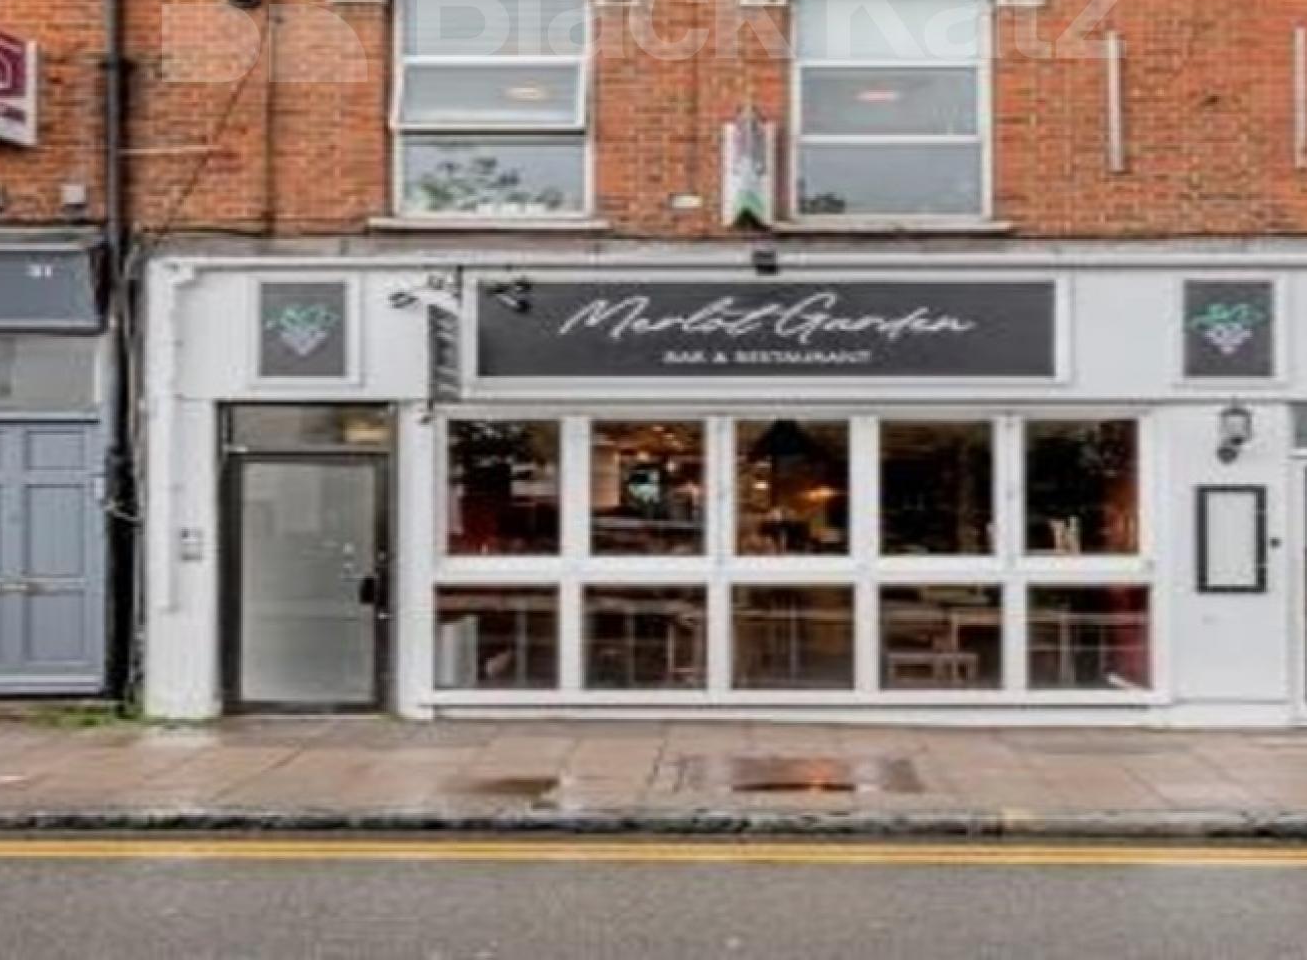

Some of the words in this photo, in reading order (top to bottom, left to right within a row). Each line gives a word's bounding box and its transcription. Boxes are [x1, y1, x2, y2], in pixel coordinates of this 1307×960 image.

[558, 294, 784, 340] Merlot
[773, 291, 980, 344] Garden
[662, 350, 708, 364] BAR
[735, 350, 873, 364] RESTAURANT
